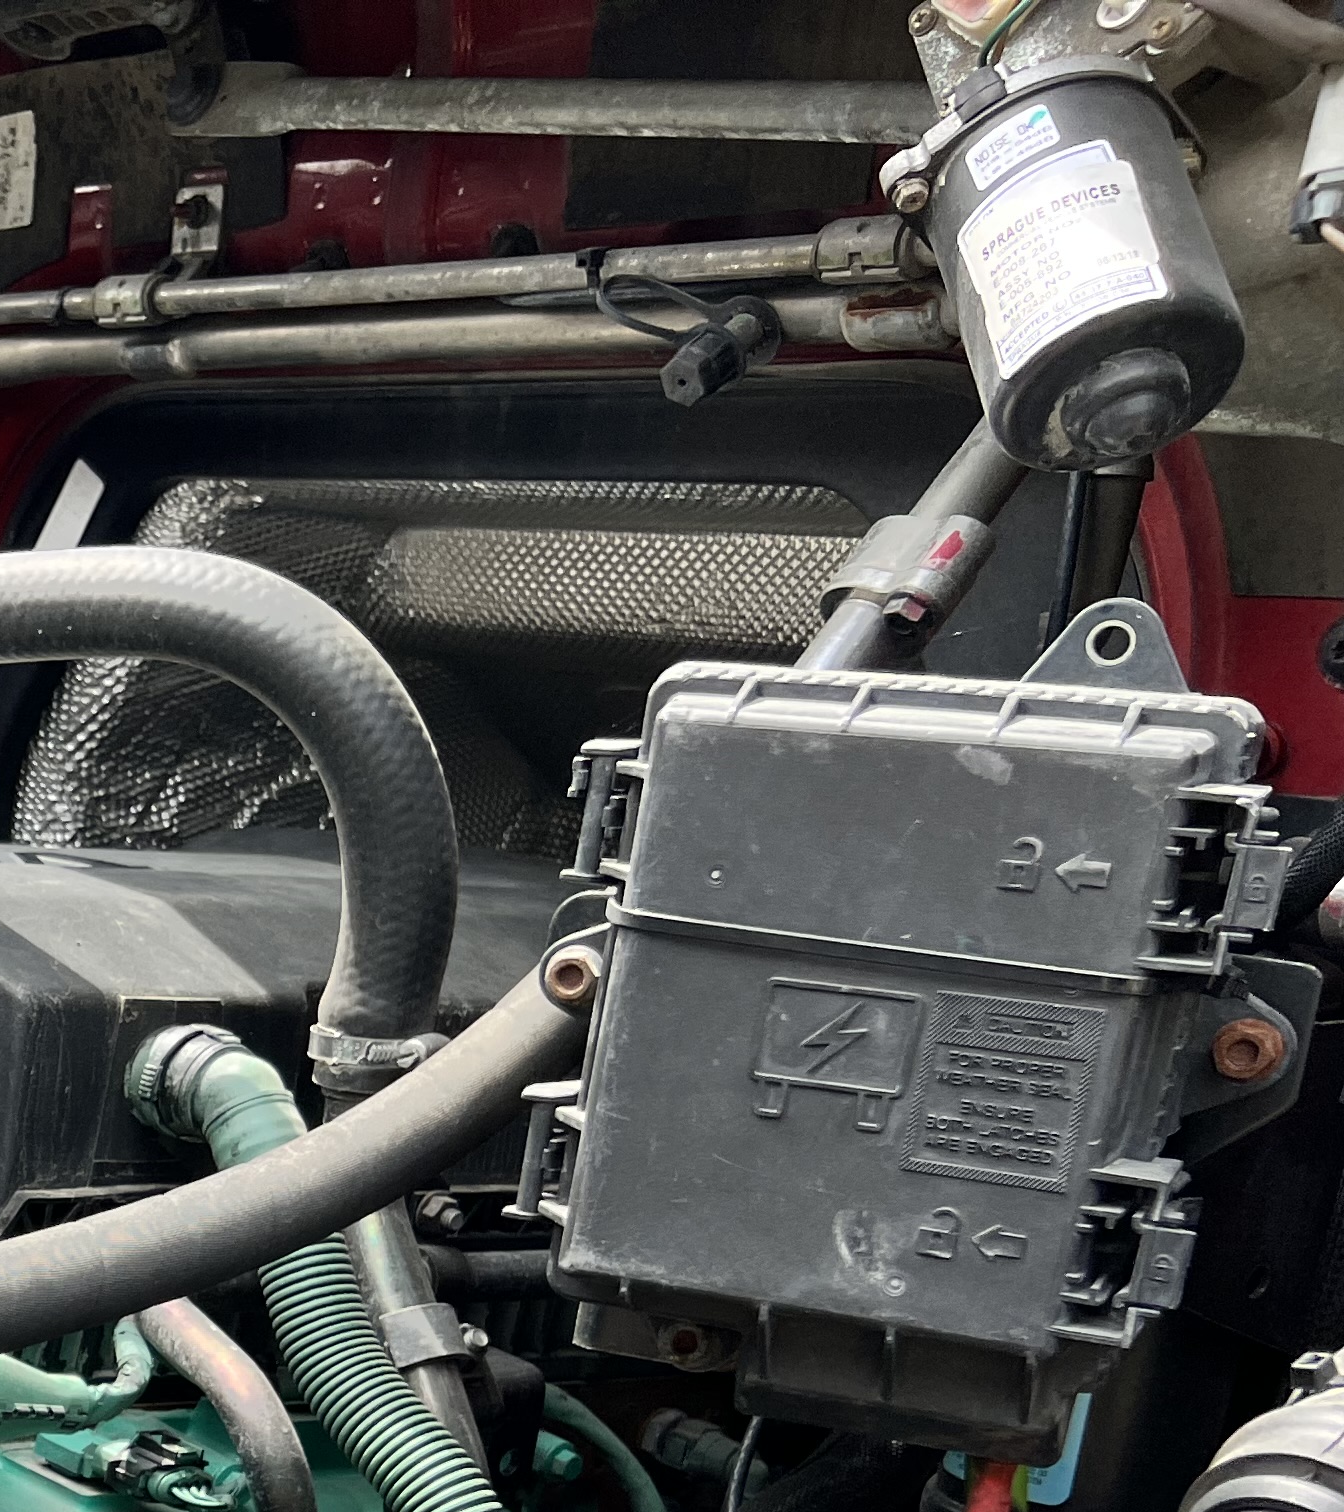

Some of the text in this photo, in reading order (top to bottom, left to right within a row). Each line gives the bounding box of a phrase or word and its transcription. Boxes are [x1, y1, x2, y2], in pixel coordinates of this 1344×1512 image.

[974, 132, 1012, 168] NOISE
[981, 207, 1046, 261] SPRAGUE
[1050, 184, 1121, 213] DEVICES
[1004, 311, 1050, 354] ACCEPTED
[949, 1049, 1065, 1078] FOR PROPER
[960, 1099, 1035, 1123] ENSURE
[924, 1134, 1055, 1165] ARE ENGAGED
